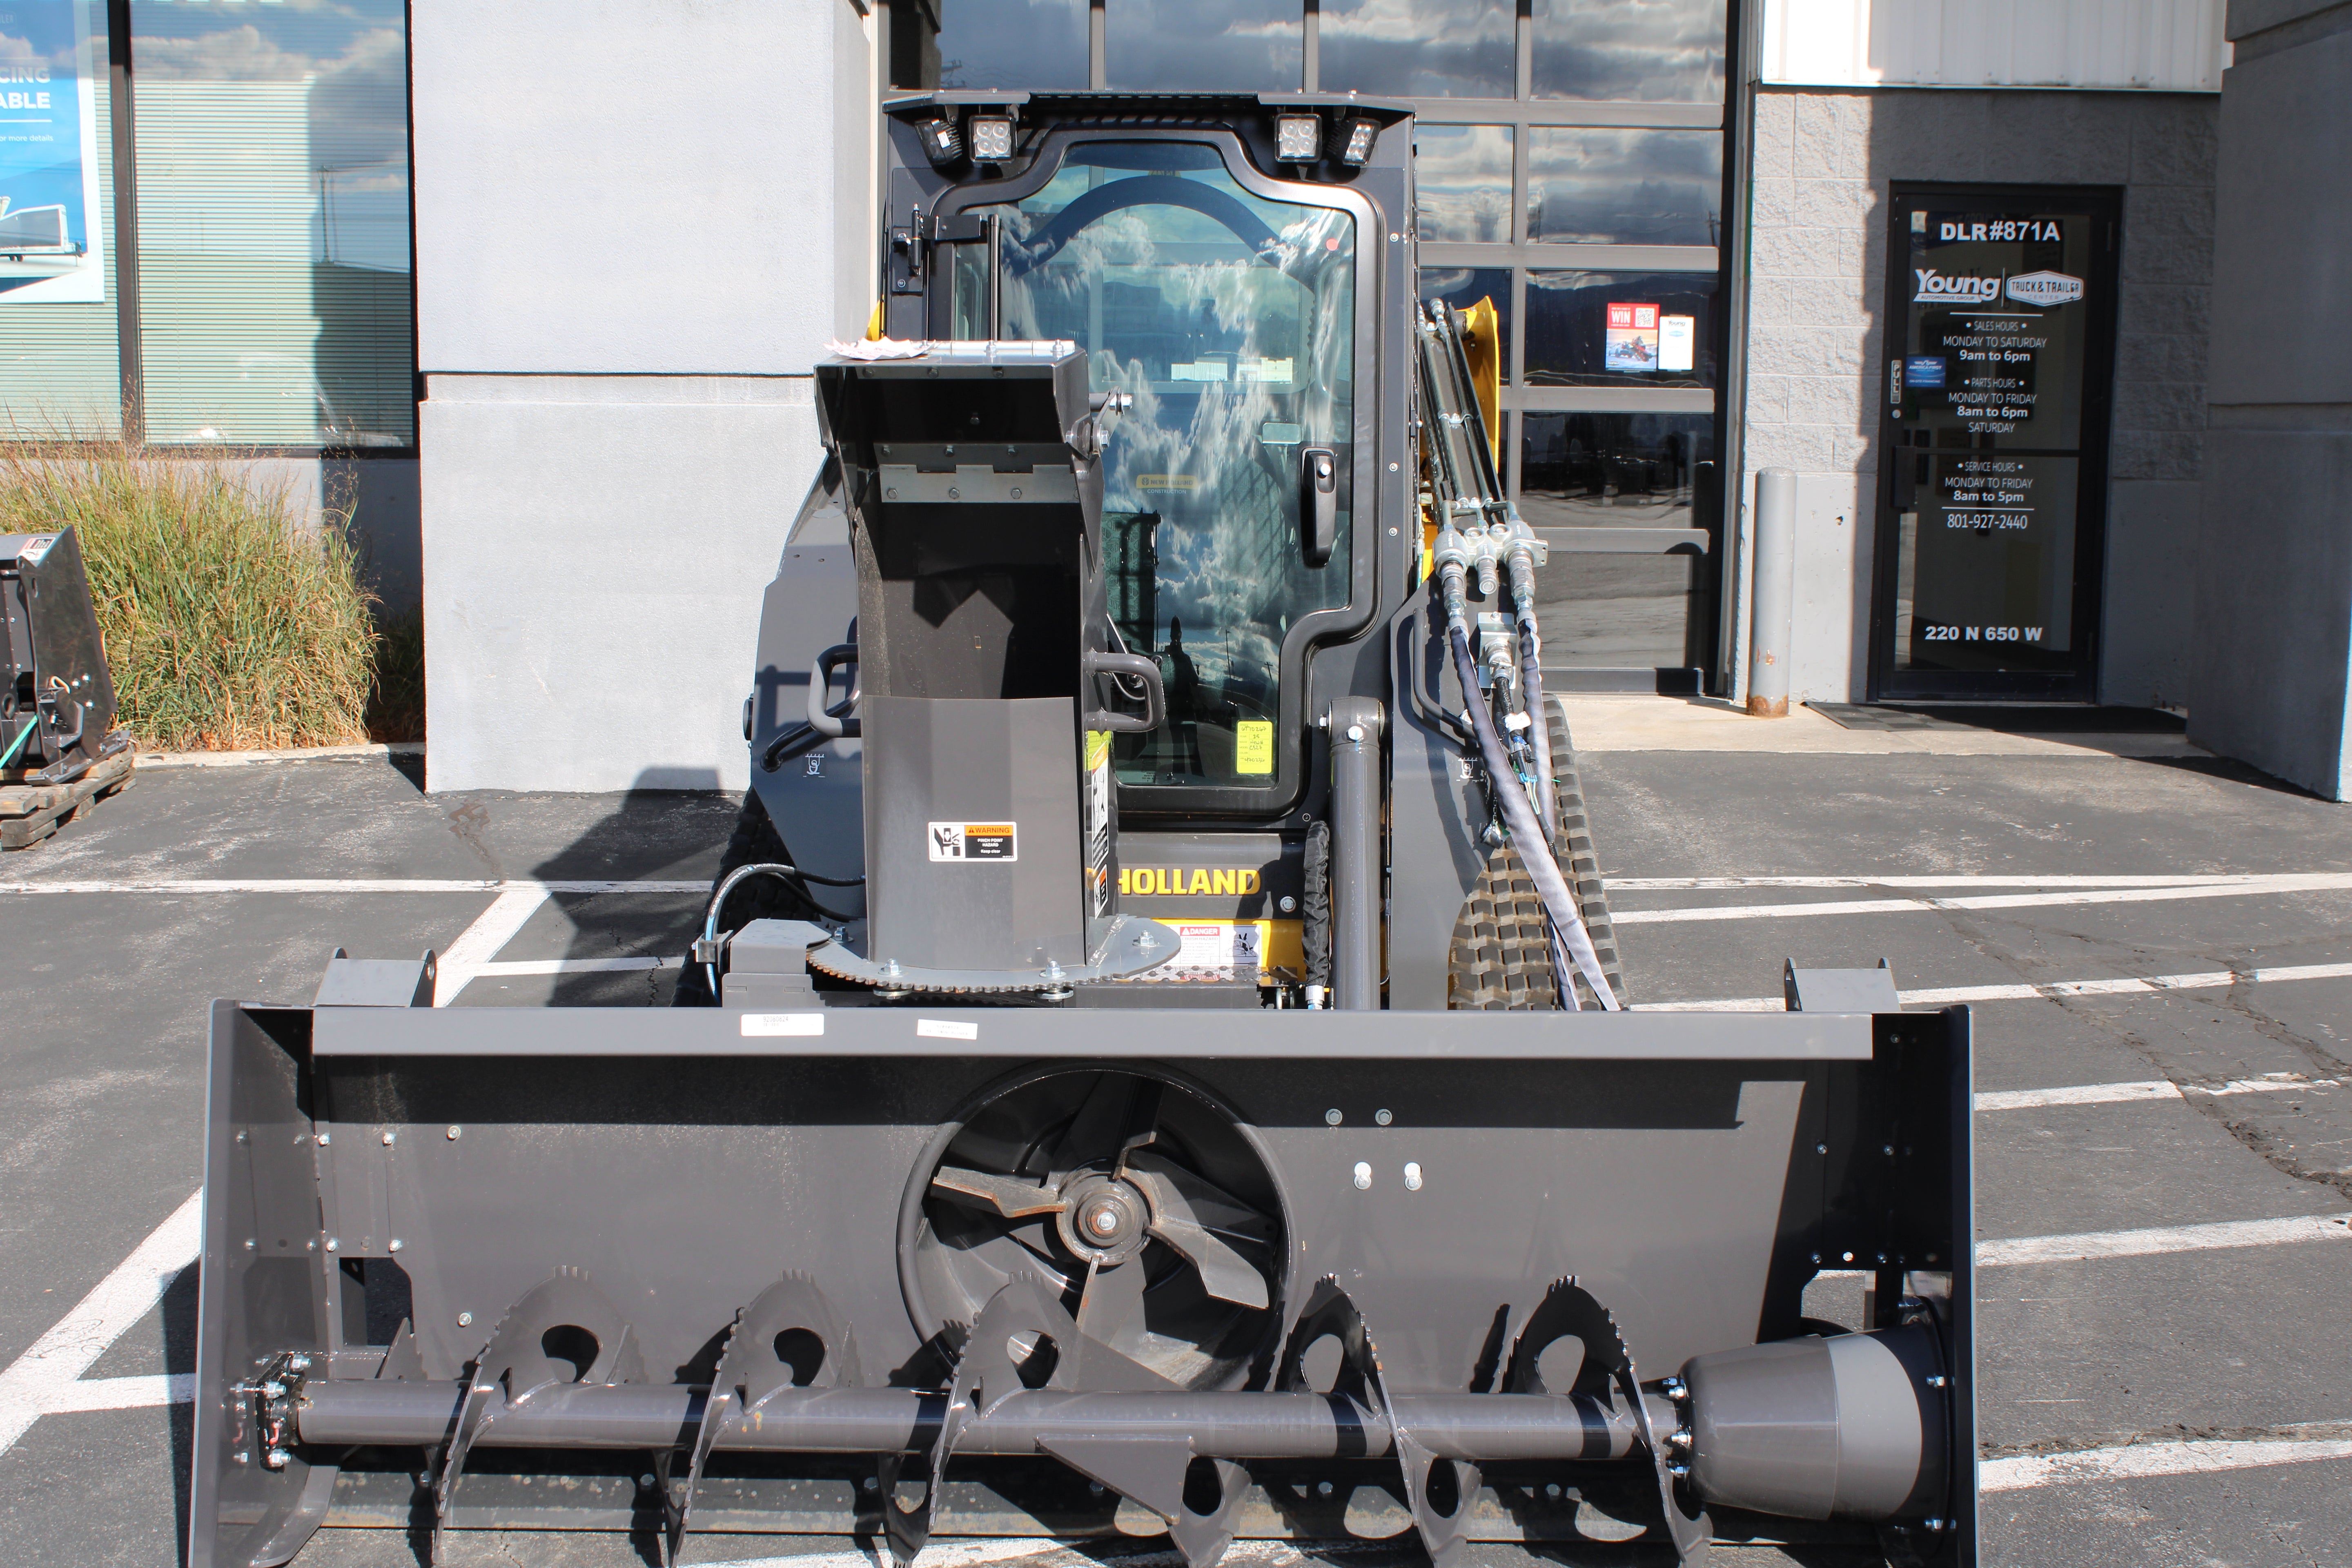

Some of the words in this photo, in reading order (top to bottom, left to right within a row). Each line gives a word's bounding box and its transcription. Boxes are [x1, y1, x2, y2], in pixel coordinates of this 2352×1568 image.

[1941, 220, 2060, 241] DLR#871A
[1915, 269, 2001, 301] Young
[2012, 282, 2036, 292] TRUCK
[2038, 281, 2044, 292] &
[2046, 282, 2079, 293] TRAILER
[1611, 310, 1630, 323] WIN
[1973, 321, 1994, 331] SALES
[1995, 321, 2018, 331] HOURS
[1943, 336, 1984, 347] MONDAY
[1986, 336, 1998, 347] TO
[2000, 337, 2047, 348] SATURDAY
[1960, 350, 1985, 360] 9am
[1988, 352, 2001, 361] to
[2004, 350, 2031, 363] 6pm
[1971, 377, 1992, 388] PARTS
[1993, 378, 2016, 388] HOURS
[1949, 392, 1989, 403] MONDAY
[1991, 393, 2003, 403] TO
[2006, 394, 2037, 404] FRIDAY
[1957, 405, 1983, 416] 8am
[1986, 408, 1999, 416] to
[2002, 406, 2029, 419] 6pm
[1968, 422, 2016, 433] SATURDAY
[1964, 461, 1991, 471] SERVICE
[1992, 462, 2016, 472] HOURS
[1945, 477, 1985, 488] MONDAY
[1987, 478, 2000, 488] TO
[2002, 478, 2034, 489] FRIDAY
[1953, 490, 1979, 501] 8am
[1982, 492, 1995, 501] to
[1998, 491, 2024, 503] 5pm
[1947, 514, 2028, 529] 801-927-2440
[1925, 626, 1960, 640] 220
[1966, 626, 1980, 640] N
[1985, 627, 2019, 641] 650
[2025, 627, 2042, 641] W
[1118, 869, 1261, 895] HOLLAND
